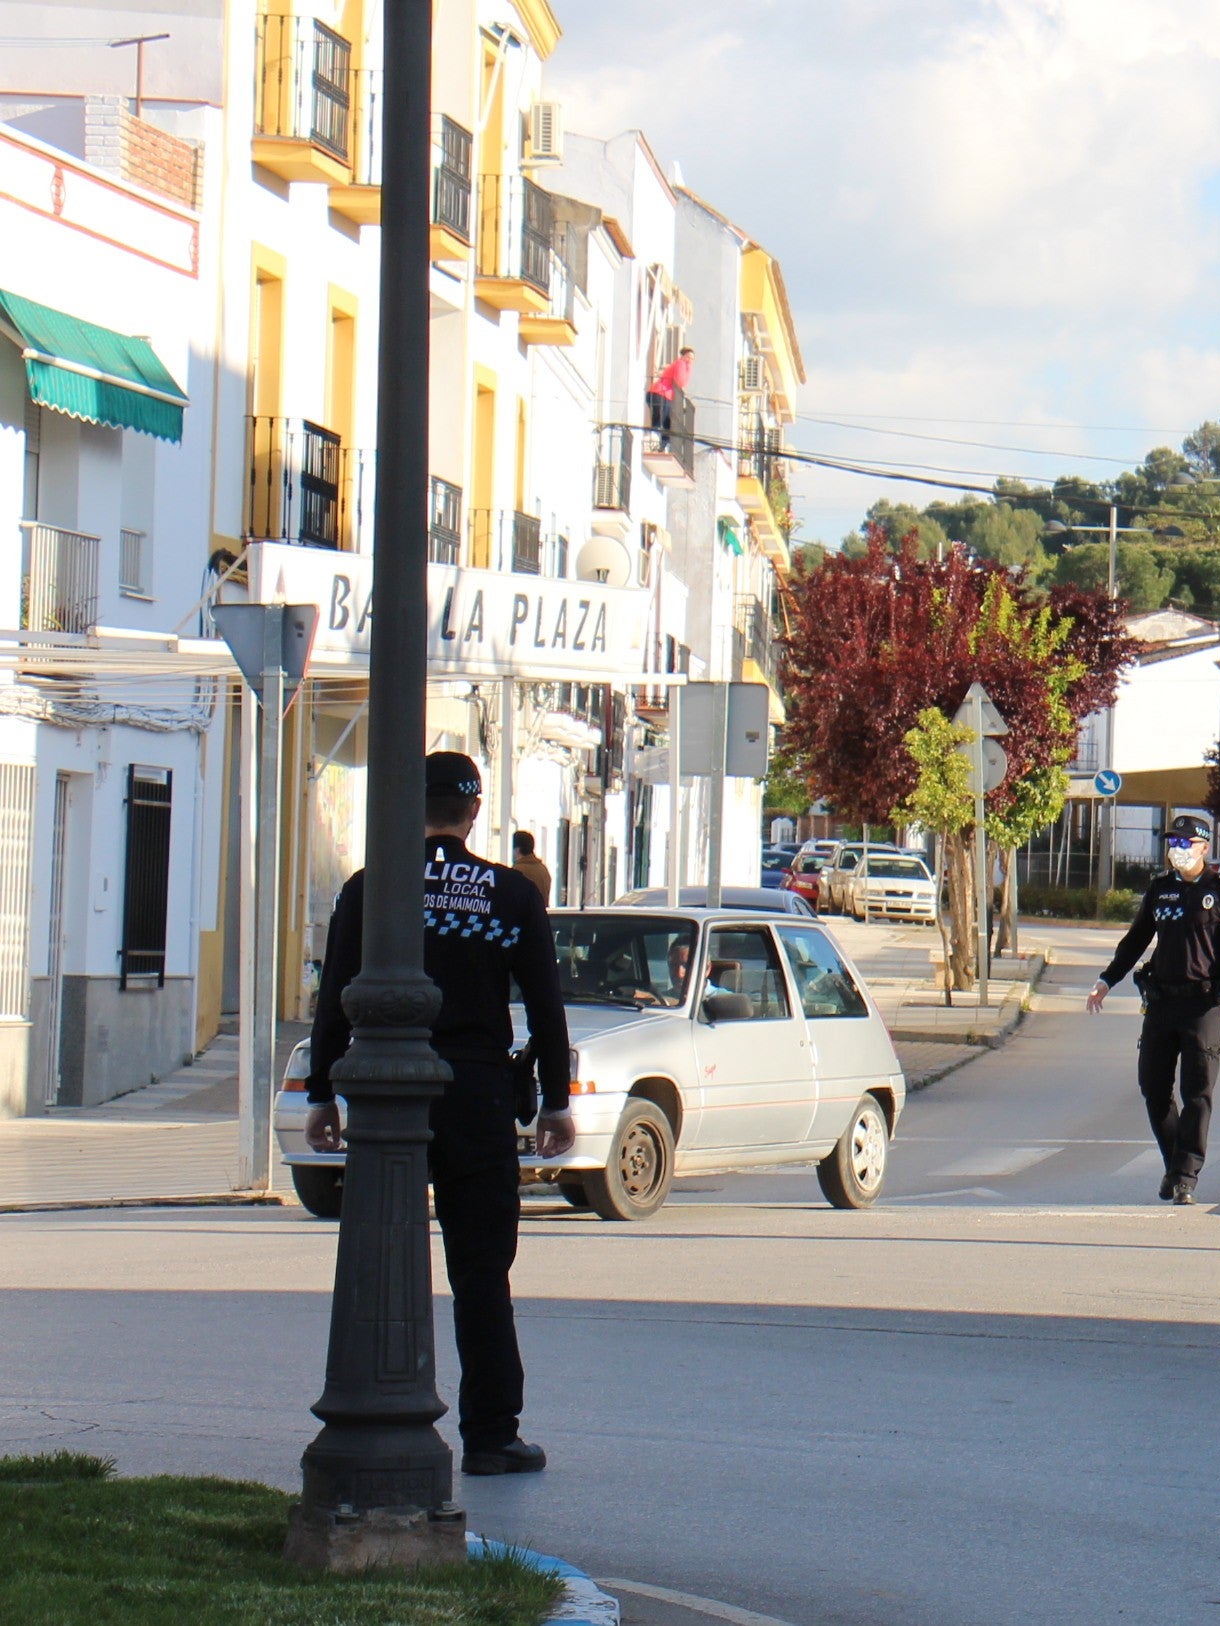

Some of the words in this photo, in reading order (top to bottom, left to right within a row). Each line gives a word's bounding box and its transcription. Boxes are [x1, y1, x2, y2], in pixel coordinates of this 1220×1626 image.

[441, 586, 484, 643] LA
[509, 593, 607, 653] PLAZA
[443, 882, 486, 898] LOCAL
[436, 895, 449, 909] DE
[448, 896, 491, 914] MAIMONA
